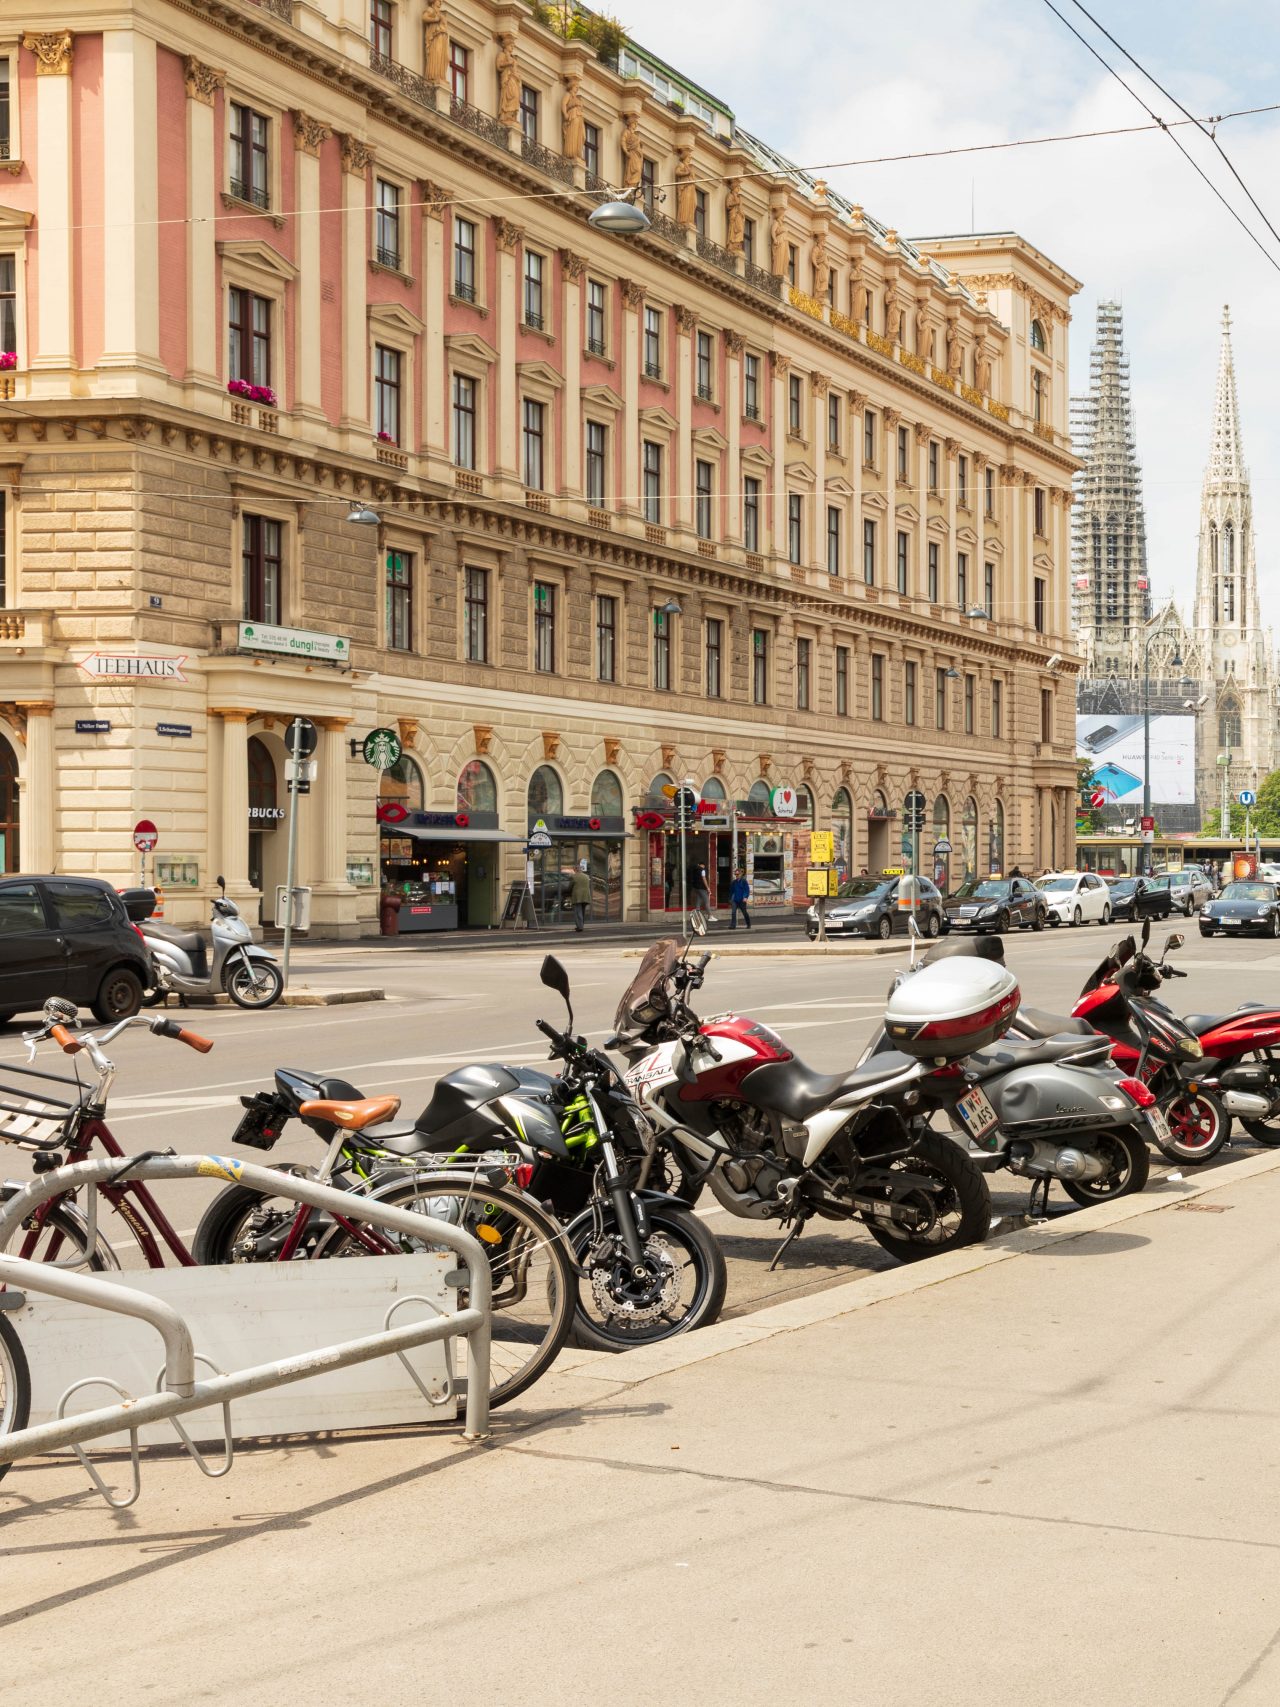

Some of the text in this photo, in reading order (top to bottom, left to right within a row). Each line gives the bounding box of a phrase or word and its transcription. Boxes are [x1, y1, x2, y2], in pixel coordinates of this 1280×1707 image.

[290, 638, 314, 652] dungl
[94, 658, 175, 676] TEEHAUS
[1241, 793, 1251, 804] U
[248, 807, 285, 818] RBUCKS
[965, 1098, 977, 1113] W
[977, 1106, 993, 1128] AFS
